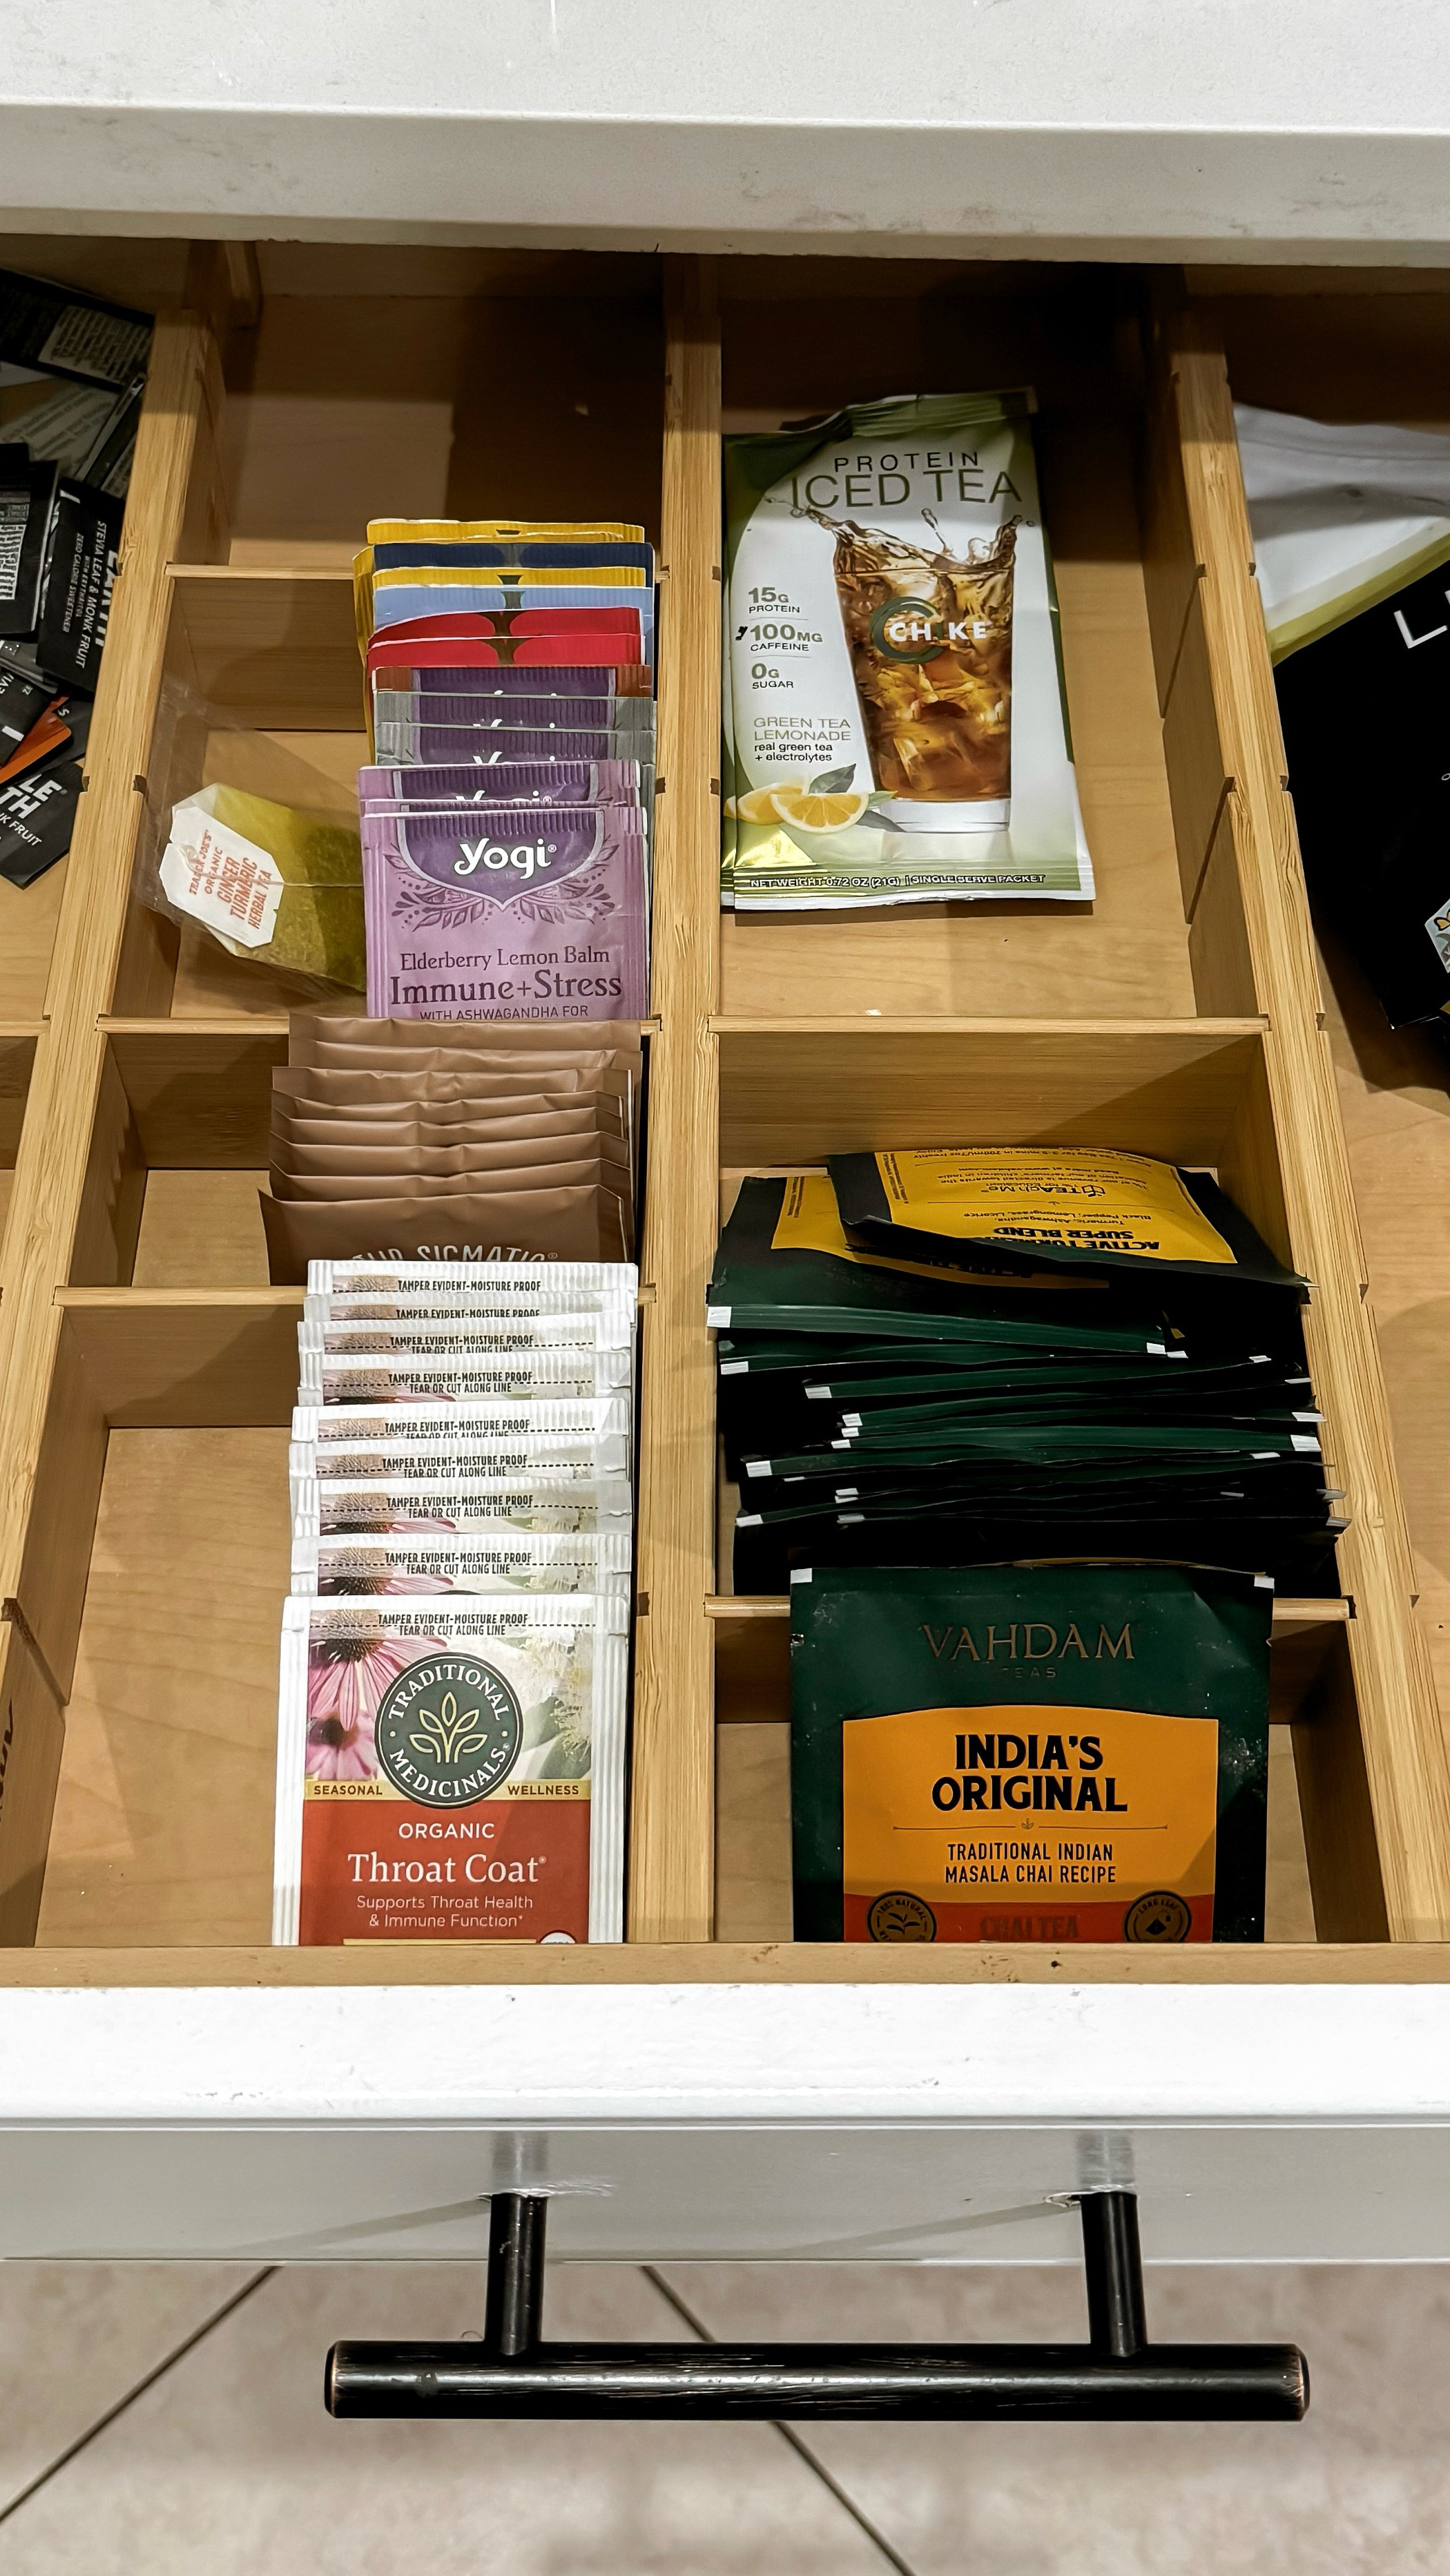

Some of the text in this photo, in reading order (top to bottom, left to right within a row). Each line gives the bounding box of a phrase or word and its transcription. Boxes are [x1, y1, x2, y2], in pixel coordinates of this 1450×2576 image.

[834, 451, 978, 472] PROTEIN
[791, 469, 1022, 510] ICED TEA
[94, 521, 107, 555] STEVIA
[91, 558, 103, 589] LEAF
[84, 597, 98, 629] MONK
[748, 604, 800, 615] PROTEIN
[75, 633, 90, 669] FRUIT
[751, 643, 809, 653] CAFFEINE
[752, 680, 794, 690] SUGAR
[754, 718, 851, 729] GREEN TEA
[754, 730, 852, 741] LEMONADE
[754, 742, 833, 754] real green tea
[766, 751, 833, 762] electrolytes
[9, 820, 42, 846] FRUIT
[204, 847, 223, 894] ORGANIC
[217, 856, 240, 903] GINGER
[751, 874, 1046, 888] NET WEIGHT 0.72 OZ (21G) SINGLE SERVE PACKET
[230, 856, 258, 920] TURMERIC
[248, 869, 273, 930] HERBAL TEA
[400, 945, 610, 971] Elderberry Lemon Balm
[420, 1005, 588, 1020] WITH ASHWAGANDHA FOR
[993, 1227, 1134, 1240] SUPER BLEND
[1084, 1240, 1159, 1249] ACTIVE
[398, 1280, 541, 1291] TAMPER EVIDENT-MOISTURE PROOF
[396, 1309, 540, 1319] TAMPER EVIDENT-MOISTURE PROOF
[390, 1334, 534, 1347] TAMPER EVIDENT-MOISTURE PROOF
[388, 1371, 533, 1383] TAMPER EVIDENT-MOISTURE PROOF
[409, 1383, 512, 1394] TEAR OR CUT ALONG LINE
[385, 1419, 530, 1432] TAMPER EVIDENT-MOISTURE PROOF
[382, 1454, 528, 1468] TAMPER EVIDENT-MOISTURE PROOF
[403, 1466, 507, 1478] TEAR OR CUT ALONG LINE
[387, 1494, 534, 1508] TAMPER EVIDENT-MOISTURE PROOF
[408, 1506, 512, 1518] TEAR OR CUT ALONG LINE
[385, 1552, 532, 1563] TAMPER EVIDENT-MOISTURE PROOF
[406, 1564, 510, 1574] TEAR OR CUT ALONG LINE
[378, 1613, 528, 1624] TAMPER EVIDENT-MOISTURE PROOF
[399, 1625, 505, 1635] TEAR OR CUT ALONG LINE
[920, 1623, 1135, 1660] VAHDAM
[389, 1664, 510, 1722] TRADITIONAL
[955, 1733, 1103, 1771] INDIA'S
[389, 1747, 507, 1798] MEDICINALS
[313, 1785, 579, 1796] SEASONAL WELLNESS
[931, 1775, 1128, 1813] ORIGINAL
[398, 1823, 495, 1839] ORGANIC
[947, 1843, 1114, 1862] TRADITIONAL INDIAN
[347, 1852, 456, 1883] Throat
[945, 1865, 1116, 1884] MASALA CHAI RECIPE
[357, 1895, 533, 1911] Supports Throat Health
[369, 1914, 379, 1927] &
[385, 1914, 445, 1927] Immune
